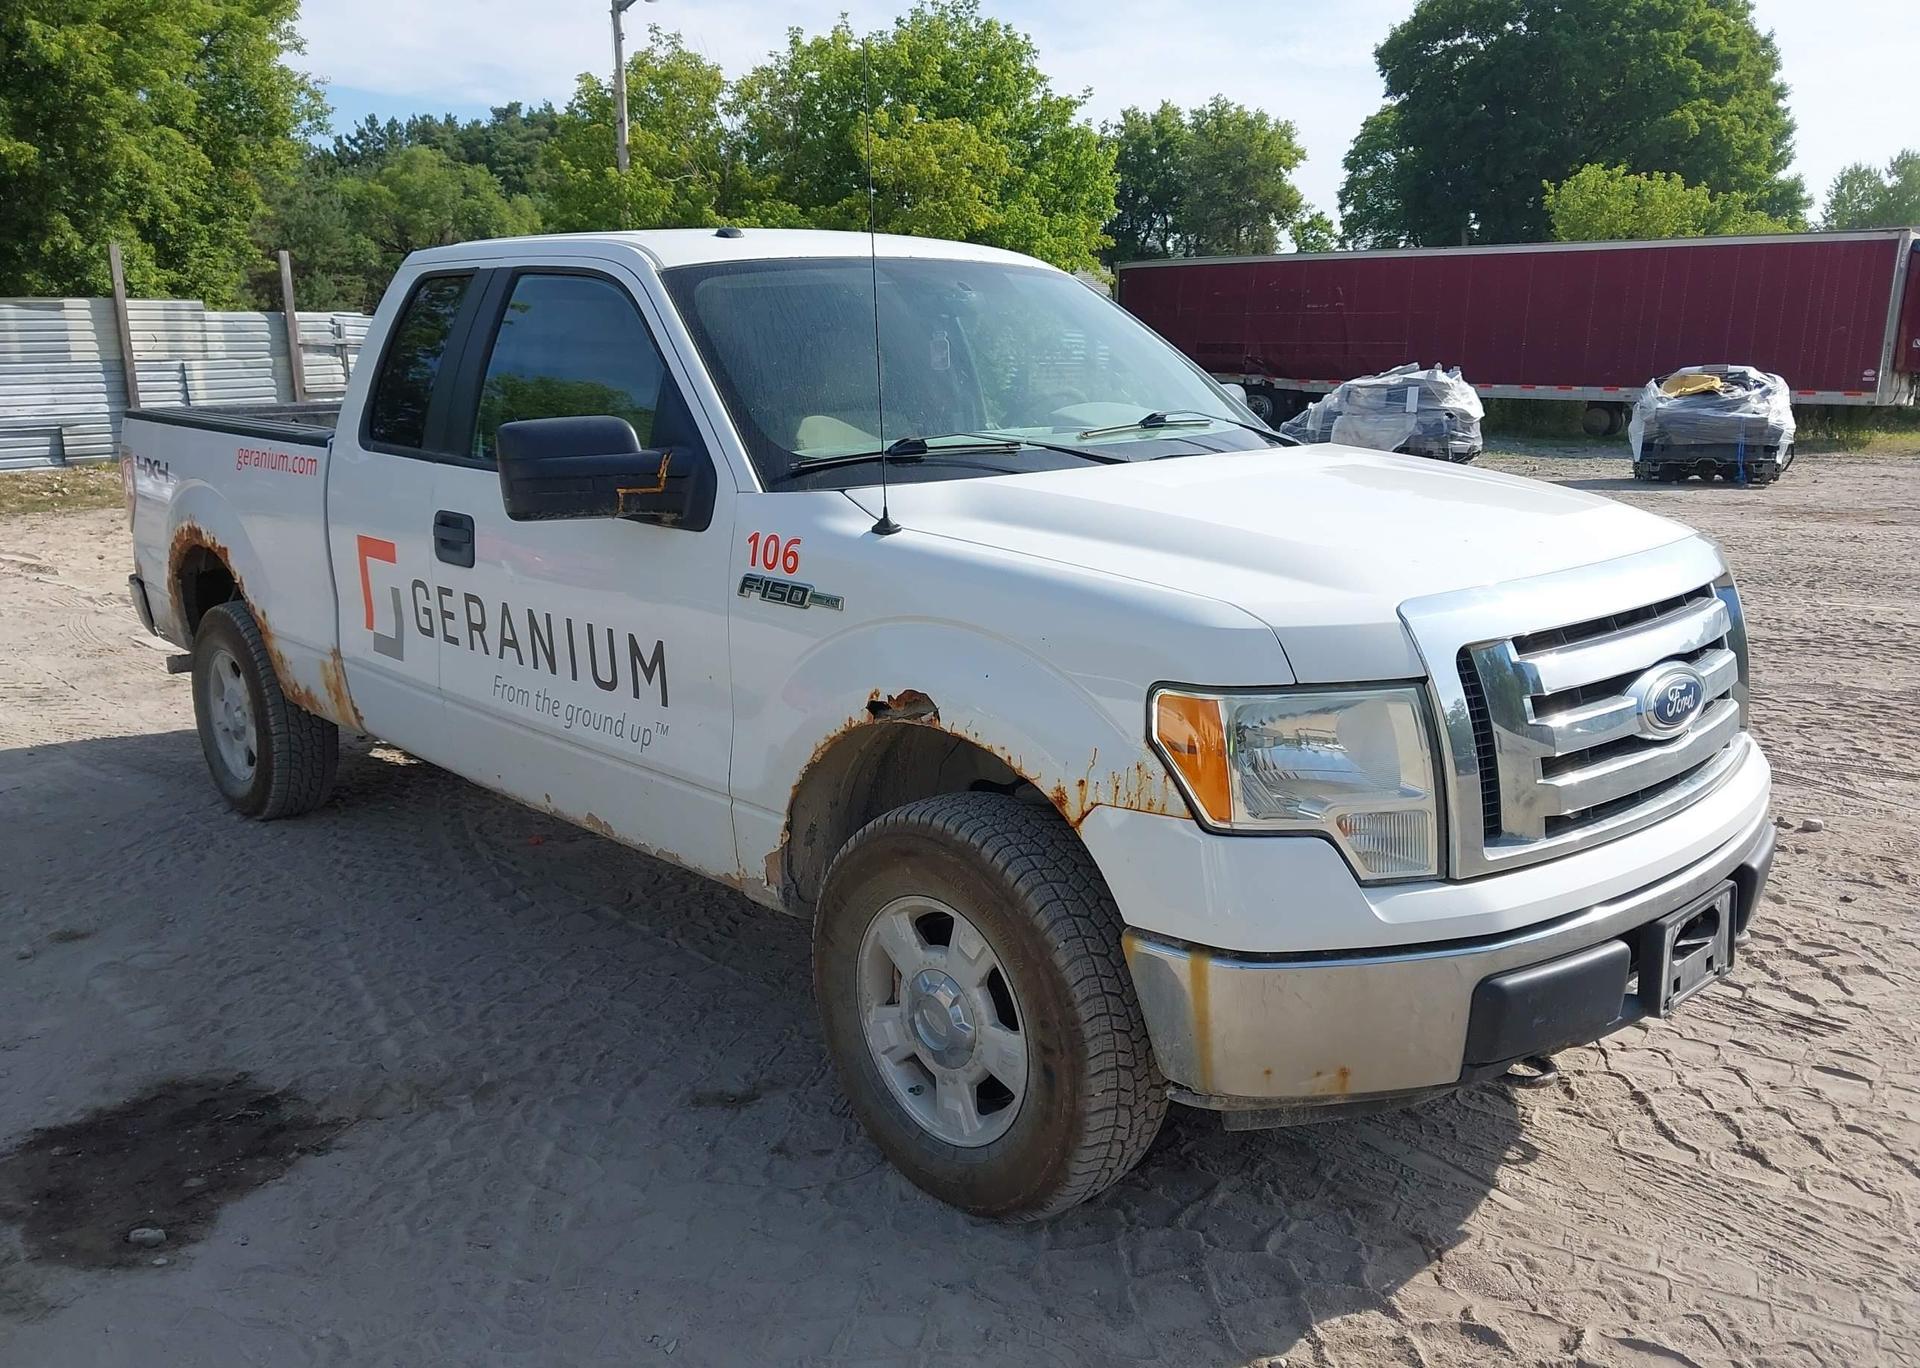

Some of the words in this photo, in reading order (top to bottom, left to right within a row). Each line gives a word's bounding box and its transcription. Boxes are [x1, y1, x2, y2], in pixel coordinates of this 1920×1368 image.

[236, 447, 318, 476] geranium.com
[747, 531, 802, 574] 106
[739, 574, 813, 608] F-150
[411, 579, 669, 707] GERANIUM
[493, 675, 530, 707] From
[535, 688, 560, 717] the
[564, 702, 626, 738] ground
[1666, 683, 1695, 717] Ford
